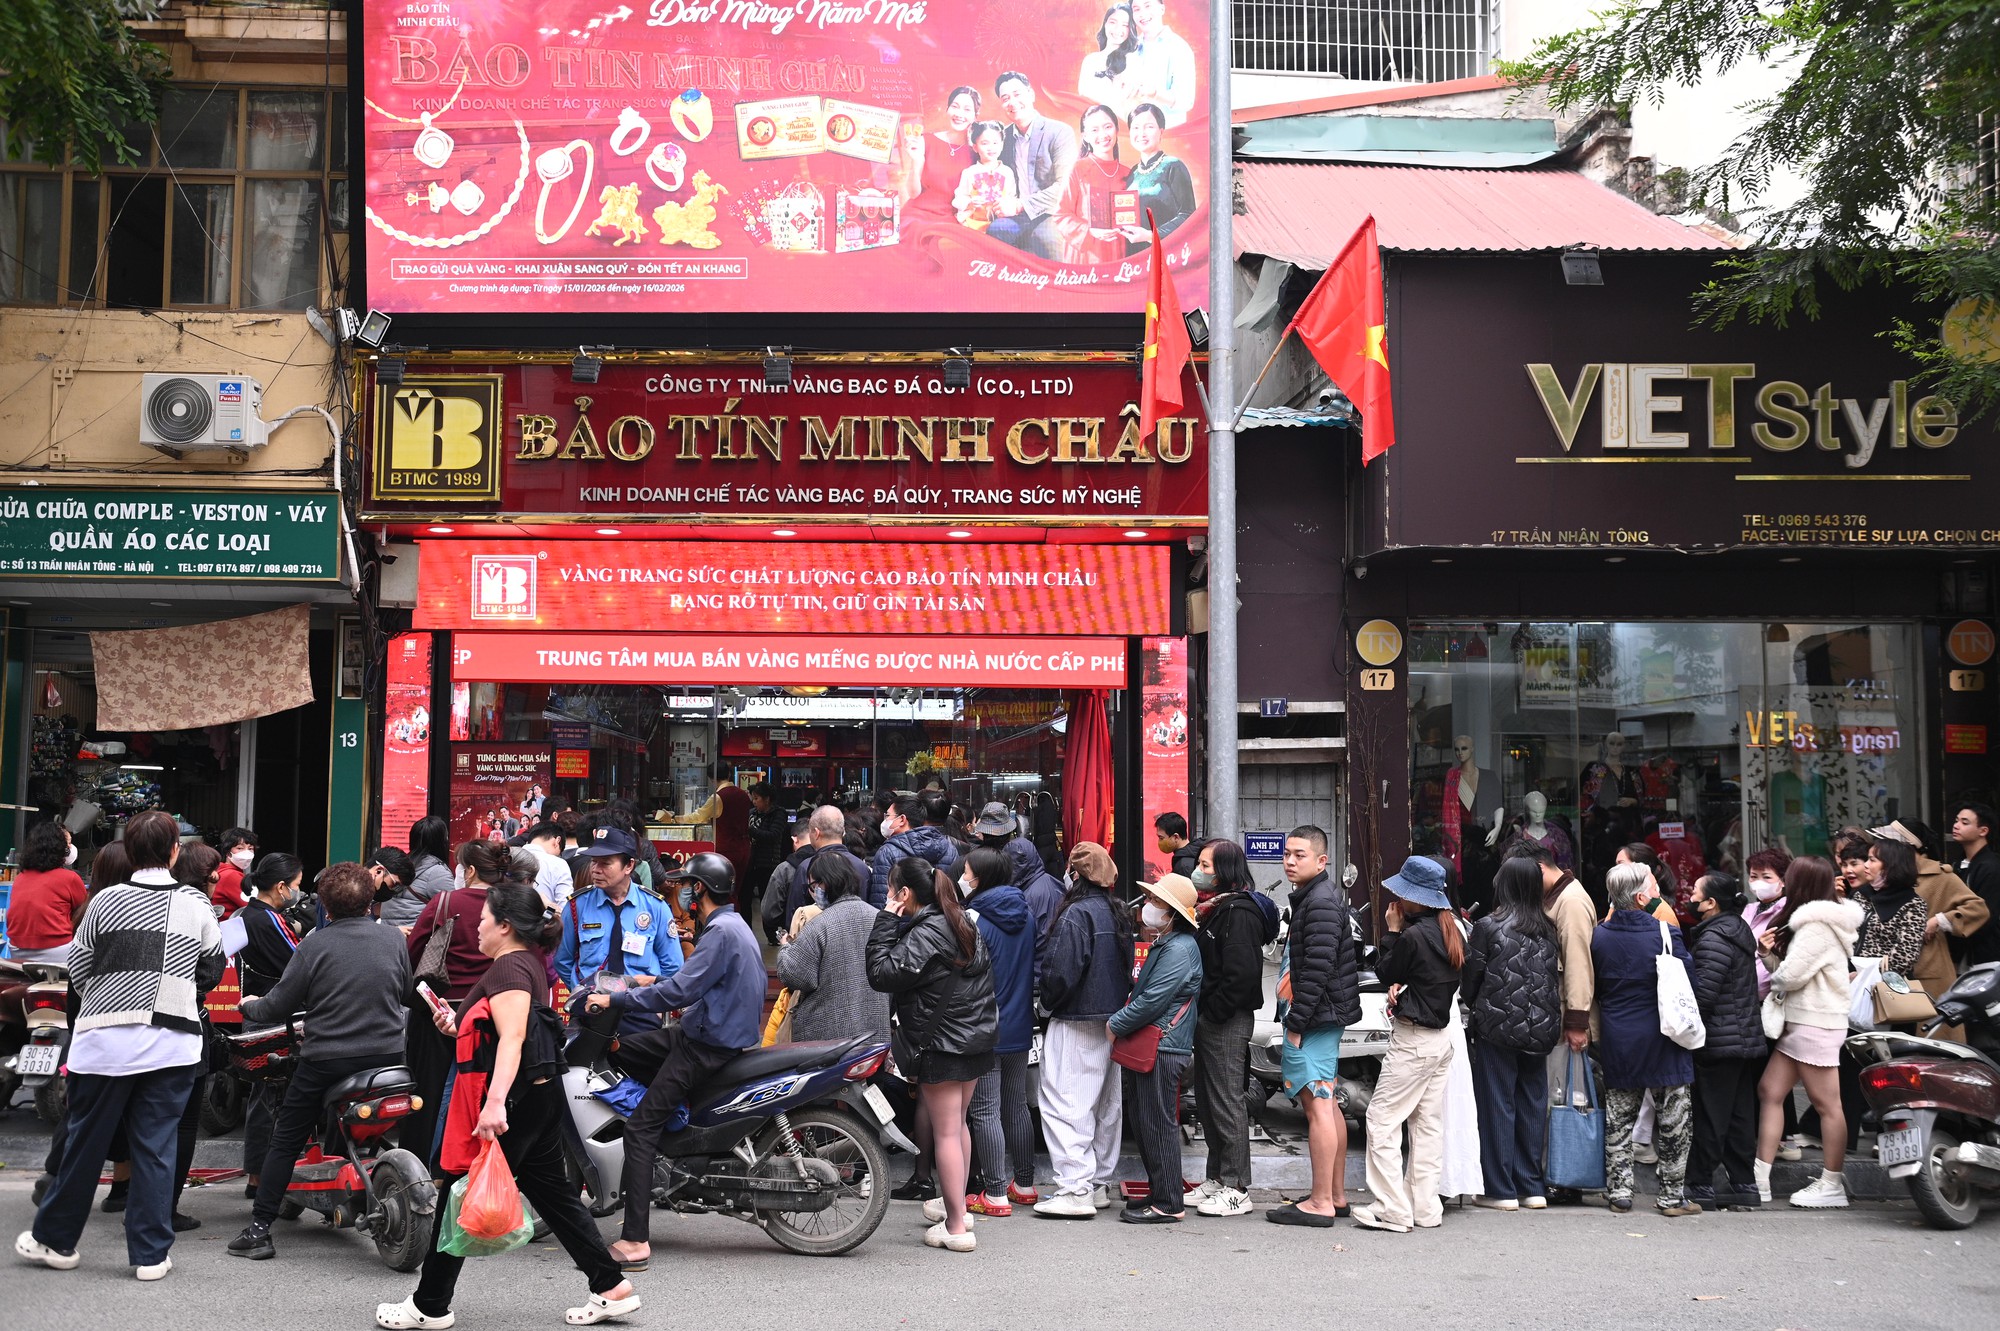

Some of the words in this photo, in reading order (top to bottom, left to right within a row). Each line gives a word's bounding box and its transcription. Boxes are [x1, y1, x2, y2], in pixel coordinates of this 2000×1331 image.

[432, 1, 450, 13] TÍN
[397, 18, 427, 27] MINH
[429, 15, 460, 27] CHÂU
[646, 0, 712, 26] Đón
[710, 0, 796, 35] Mừng
[796, 0, 867, 29] Năm
[864, 0, 928, 31] Mới
[652, 52, 774, 91] MINH
[460, 98, 516, 111] DOANH
[398, 264, 428, 274] TRAO
[430, 261, 449, 274] GỬI
[451, 262, 474, 276] QUÀ
[476, 262, 506, 274] VÀNG
[515, 264, 540, 274] KHAI
[543, 262, 572, 274] XUÂN
[575, 264, 604, 274] SANG
[606, 262, 629, 276] QUÝ
[637, 262, 662, 274] ĐÓN
[664, 261, 683, 274] TẾT
[685, 264, 700, 274] AN
[703, 264, 741, 274] KHANG
[997, 265, 1050, 291] trưởng
[1054, 269, 1098, 286] thành
[449, 283, 478, 294] Chương
[480, 283, 498, 293] trình
[510, 283, 532, 294] dụng:
[543, 284, 563, 294] ngày
[564, 283, 606, 293] 15/01/2026
[622, 284, 642, 294] ngày
[643, 283, 685, 293] 16/02/2026
[645, 373, 703, 393] CÔNG
[706, 378, 731, 393] TY
[793, 375, 844, 393] VÀNG
[848, 378, 888, 396] BẠC
[894, 375, 922, 394] ĐÁ
[1031, 377, 1074, 396] LTD)
[515, 396, 656, 462] BẢO
[667, 396, 788, 462] TÍN
[799, 415, 995, 463] MINH
[1005, 400, 1199, 465] CHÂU
[389, 471, 439, 487] BTMC
[444, 471, 482, 487] 1989
[580, 487, 621, 502] KINH
[627, 487, 690, 502] DOANH
[693, 483, 732, 503] CHẾ
[736, 484, 770, 503] TÁC
[775, 484, 823, 503] VÀNG
[828, 488, 865, 507] BẠC
[874, 485, 899, 503] ĐÁ
[952, 488, 1013, 504] TRANG
[1019, 485, 1056, 505] SỨC
[1062, 485, 1089, 504] MỸ
[1093, 485, 1142, 508] NGHỆ
[0, 496, 30, 519] ỬA
[36, 497, 88, 519] CHỮA
[93, 502, 173, 520] COMPLE
[191, 503, 268, 521] VESTON
[288, 500, 327, 523] VÁY
[1743, 514, 1775, 526] TEL:
[1778, 514, 1811, 526] 0969
[1814, 514, 1840, 526] 543
[1843, 514, 1867, 526] 376
[50, 523, 113, 552] QUẦN
[123, 527, 157, 550] ÁO
[165, 527, 210, 551] CÁC
[217, 533, 271, 556] LOẠI
[1491, 530, 1506, 542] 17
[1509, 526, 1551, 543] TRẦN
[1558, 527, 1600, 543] NHÂN
[1607, 527, 1649, 543] TÔNG
[1871, 529, 1894, 545] SỰ
[1898, 529, 1929, 545] LỰA
[1933, 529, 1977, 545] CHỌN
[12, 558, 24, 570] SỐ
[26, 560, 37, 570] 13
[64, 559, 91, 571] NHÂN
[93, 559, 116, 572] TÔNG
[124, 560, 137, 572] HÀ
[138, 560, 154, 574] NỘI
[178, 563, 197, 572] TEL:
[197, 563, 213, 573] 097
[216, 563, 237, 573] 6174
[239, 564, 256, 573] 897
[264, 564, 281, 573] 098
[282, 564, 299, 574] 499
[301, 564, 323, 574] 7314
[559, 563, 613, 583] VÀNG
[617, 567, 683, 584] TRANG
[687, 564, 726, 584] SỨC
[730, 564, 784, 584] CHẤT
[788, 568, 856, 588] LƯỢNG
[860, 570, 901, 586] CAO
[906, 565, 946, 586] BẢO
[950, 564, 983, 586] TÍN
[987, 571, 1039, 587] MINH
[1043, 566, 1098, 587] CHÂU
[670, 594, 723, 613] RẠNG
[729, 591, 757, 610] RỠ
[759, 593, 789, 613] TỰ
[790, 595, 829, 612] TIN,
[832, 592, 870, 611] GIỮ
[872, 592, 908, 611] GÌN
[912, 591, 944, 611] TÀI
[949, 590, 986, 612] SẢN
[536, 649, 602, 667] TRUNG
[607, 647, 648, 668] TÂM
[653, 650, 697, 668] MUA
[702, 647, 741, 668] BÁN
[746, 647, 800, 669] VÀNG
[875, 651, 933, 673] ĐƯỢC
[938, 650, 980, 671] NHÀ
[985, 650, 1042, 672] NƯỚC
[1047, 648, 1086, 672] CẤP
[1369, 672, 1388, 687] 17
[1958, 673, 1977, 688] 17
[1265, 700, 1282, 715] 17
[340, 734, 357, 748] 13
[519, 754, 534, 763] MUA
[476, 763, 493, 772] VÀNG
[504, 764, 524, 772] TRANG
[1250, 841, 1267, 850] ANH
[1268, 841, 1280, 850] EM
[21, 1060, 51, 1073] 3030
